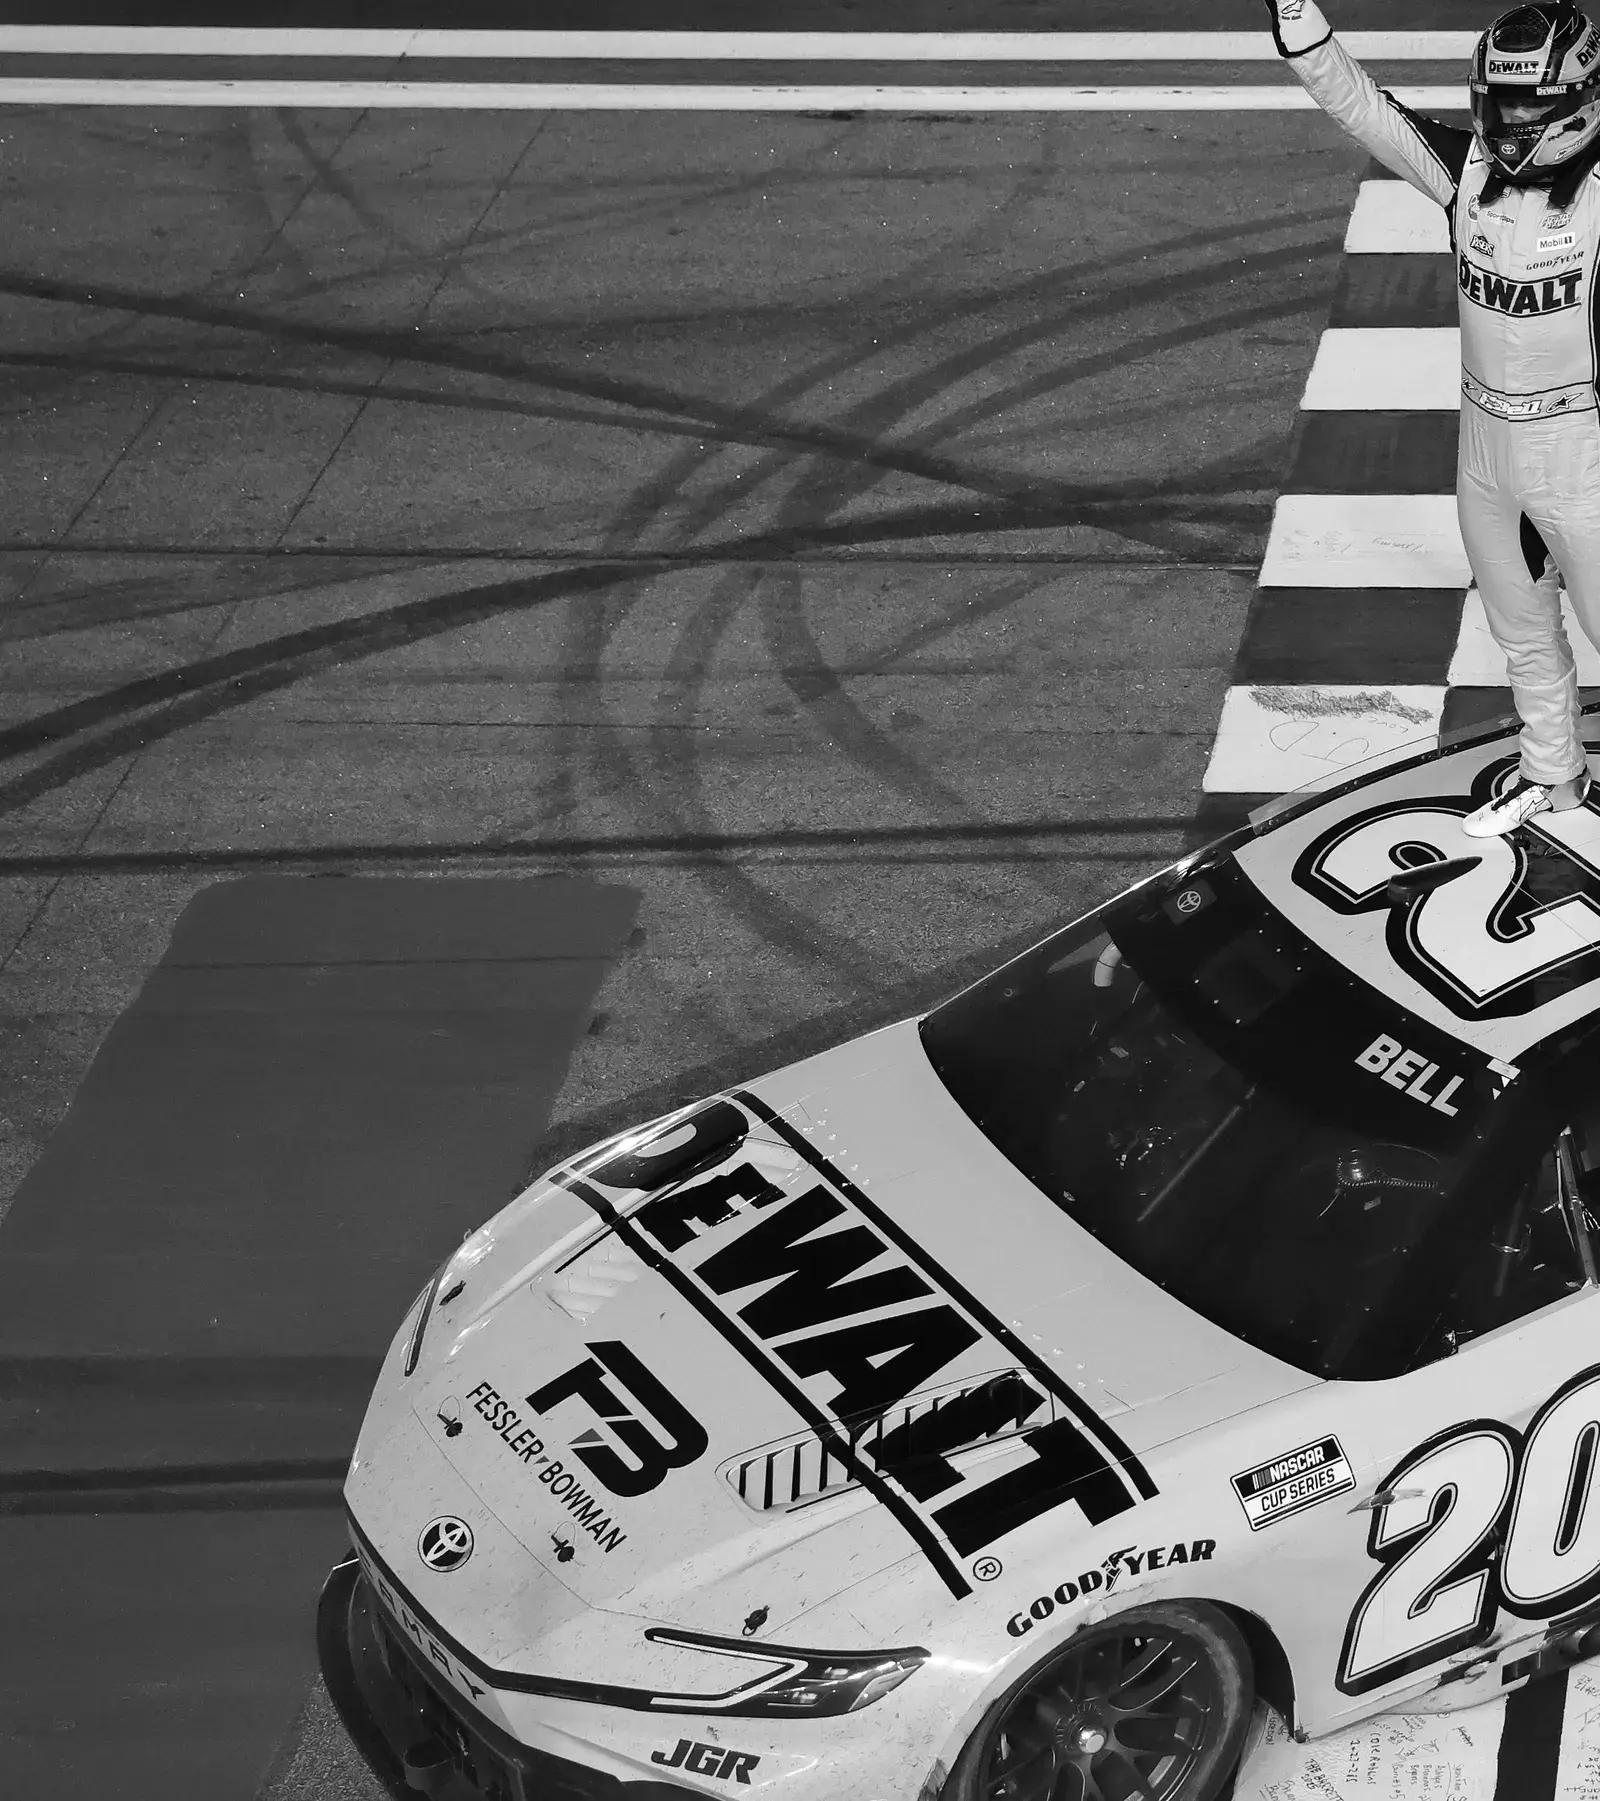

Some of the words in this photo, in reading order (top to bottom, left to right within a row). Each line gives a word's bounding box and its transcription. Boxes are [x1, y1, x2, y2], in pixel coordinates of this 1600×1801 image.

[1526, 251, 1584, 270] GOODYEAR
[1540, 238, 1563, 249] Mobil
[1459, 257, 1582, 314] DEWALT
[1354, 1033, 1465, 1117] BELL
[565, 1099, 1137, 1559] DEWALT
[465, 1380, 537, 1460] FESSLER
[539, 1460, 627, 1554] BOWMAN
[1261, 1487, 1296, 1513] CUP
[1298, 1468, 1336, 1501] SERIES
[1269, 1446, 1326, 1486] NASCAR
[1007, 1538, 1216, 1637] GOODYEAR
[650, 1739, 762, 1785] JGR
